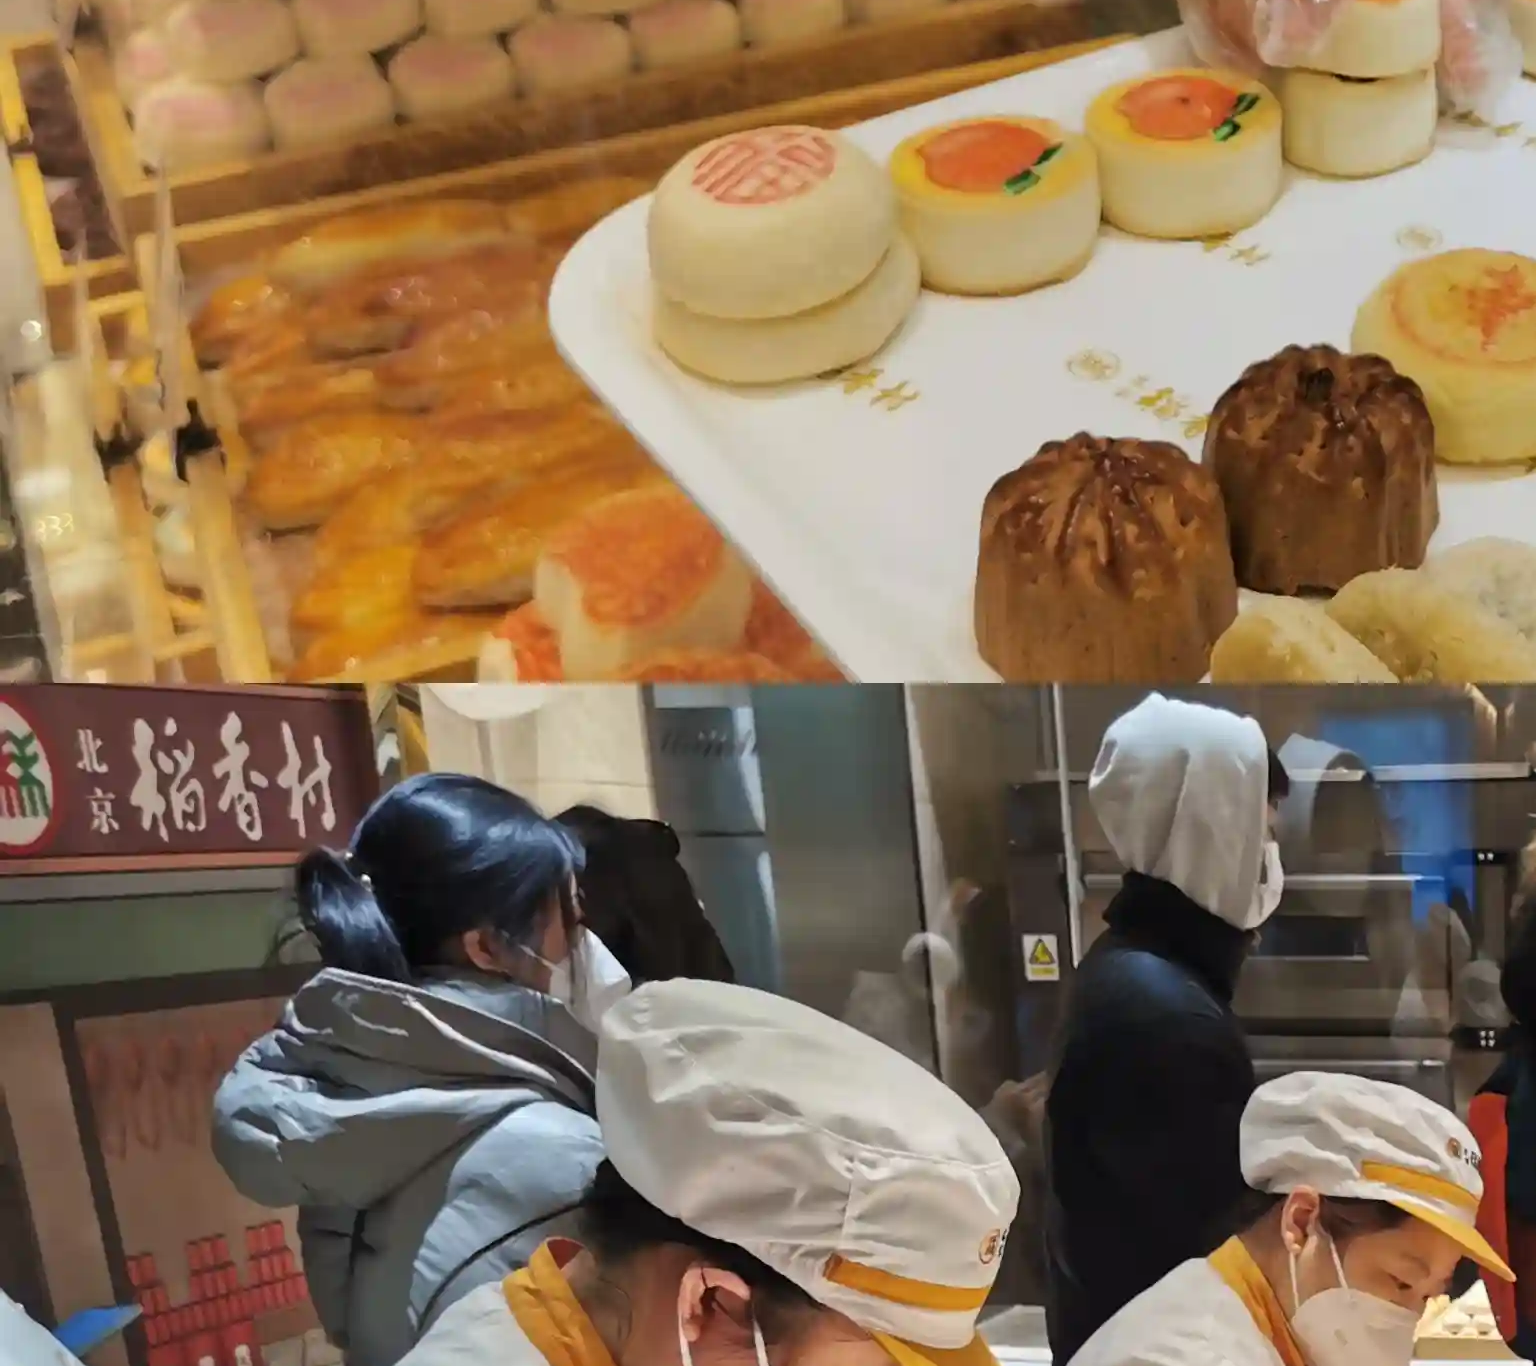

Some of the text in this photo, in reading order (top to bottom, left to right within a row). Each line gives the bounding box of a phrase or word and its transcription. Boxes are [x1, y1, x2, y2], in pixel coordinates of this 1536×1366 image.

[76, 728, 119, 835] 北京
[130, 711, 337, 842] 稻香村
